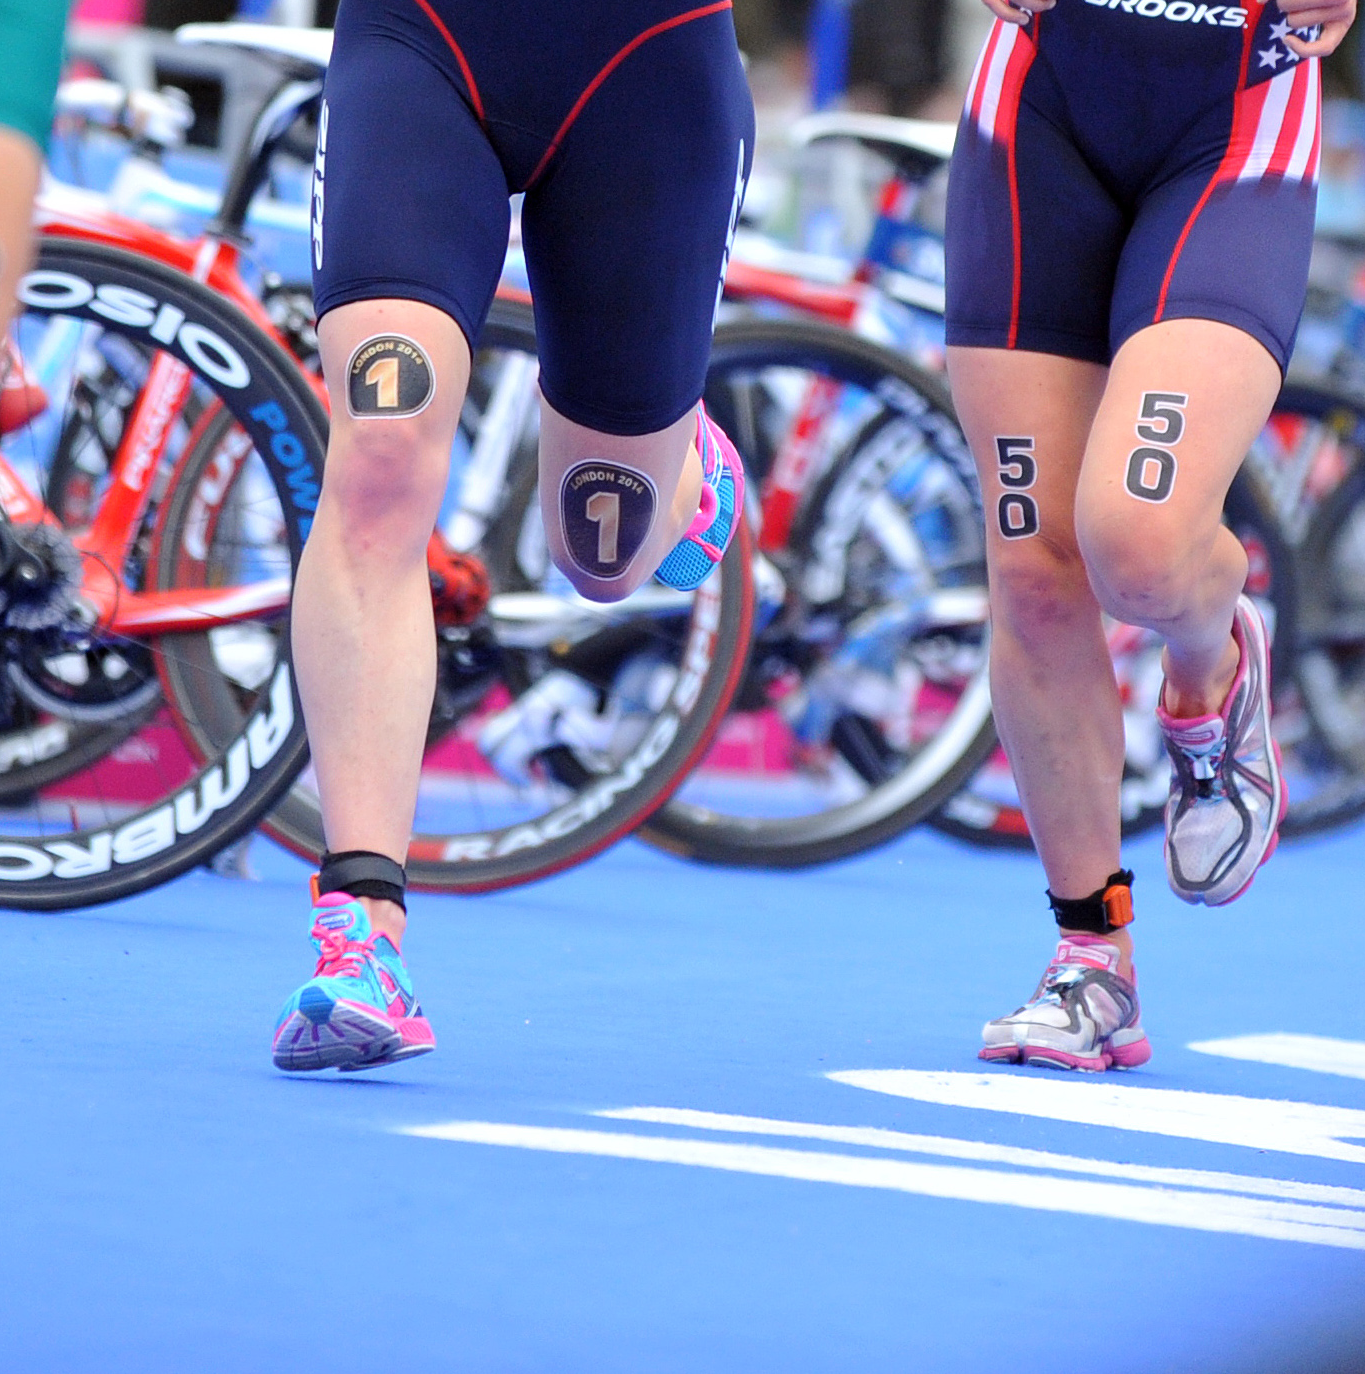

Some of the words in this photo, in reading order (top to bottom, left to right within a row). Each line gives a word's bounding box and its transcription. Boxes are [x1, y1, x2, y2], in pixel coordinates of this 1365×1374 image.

[352, 341, 394, 375] LONDON
[396, 342, 423, 366] 2014
[365, 356, 400, 409] 1
[1123, 391, 1190, 505] 50
[570, 470, 615, 492] LONDON
[617, 472, 646, 495] 2014
[995, 435, 1041, 542] 50
[585, 491, 621, 564] 1
